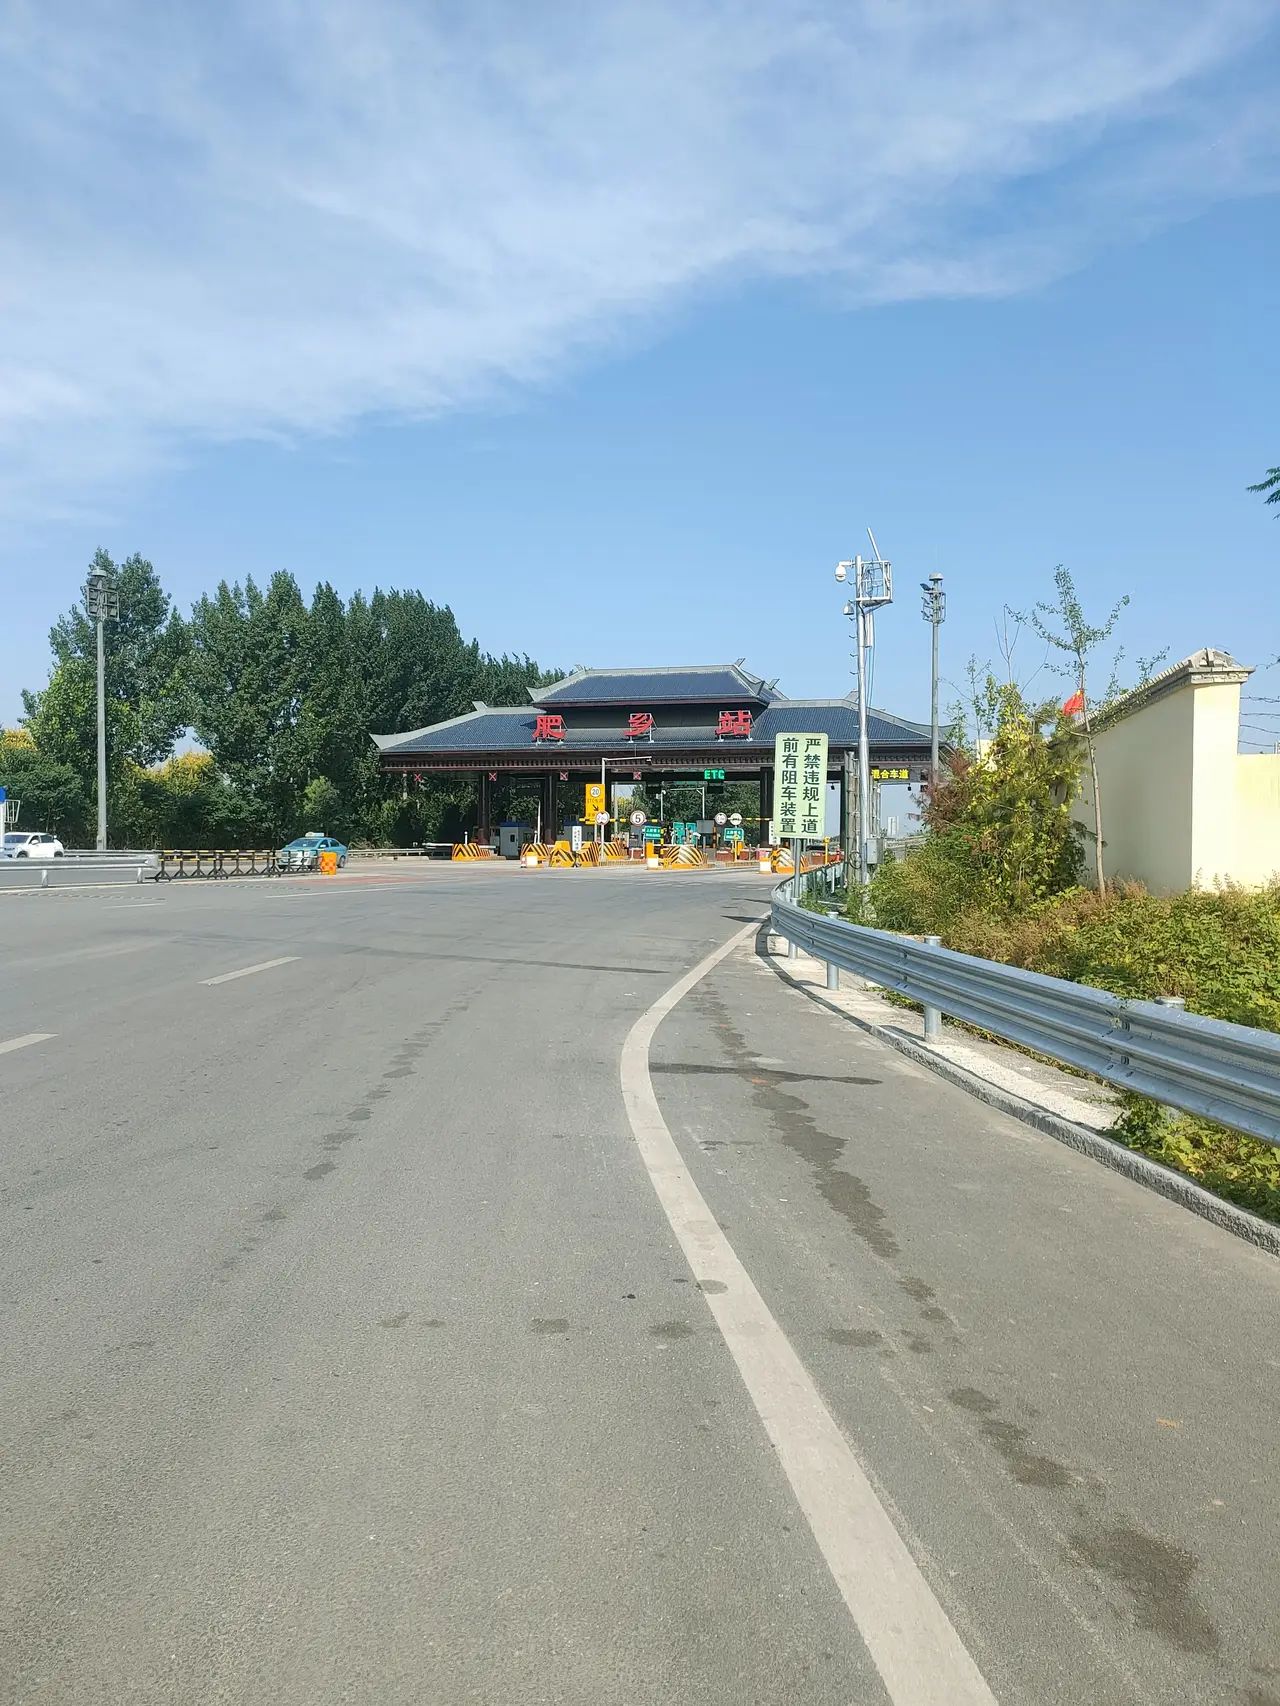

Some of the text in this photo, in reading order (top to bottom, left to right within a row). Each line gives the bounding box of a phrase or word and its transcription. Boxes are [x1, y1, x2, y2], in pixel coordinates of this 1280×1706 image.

[532, 709, 753, 739] 肥乡站
[704, 768, 725, 780] ETC
[871, 769, 909, 779] 混合车道
[780, 737, 799, 834] 前有阻车装置
[801, 738, 821, 834] 严禁违规上道
[635, 814, 641, 823] 5
